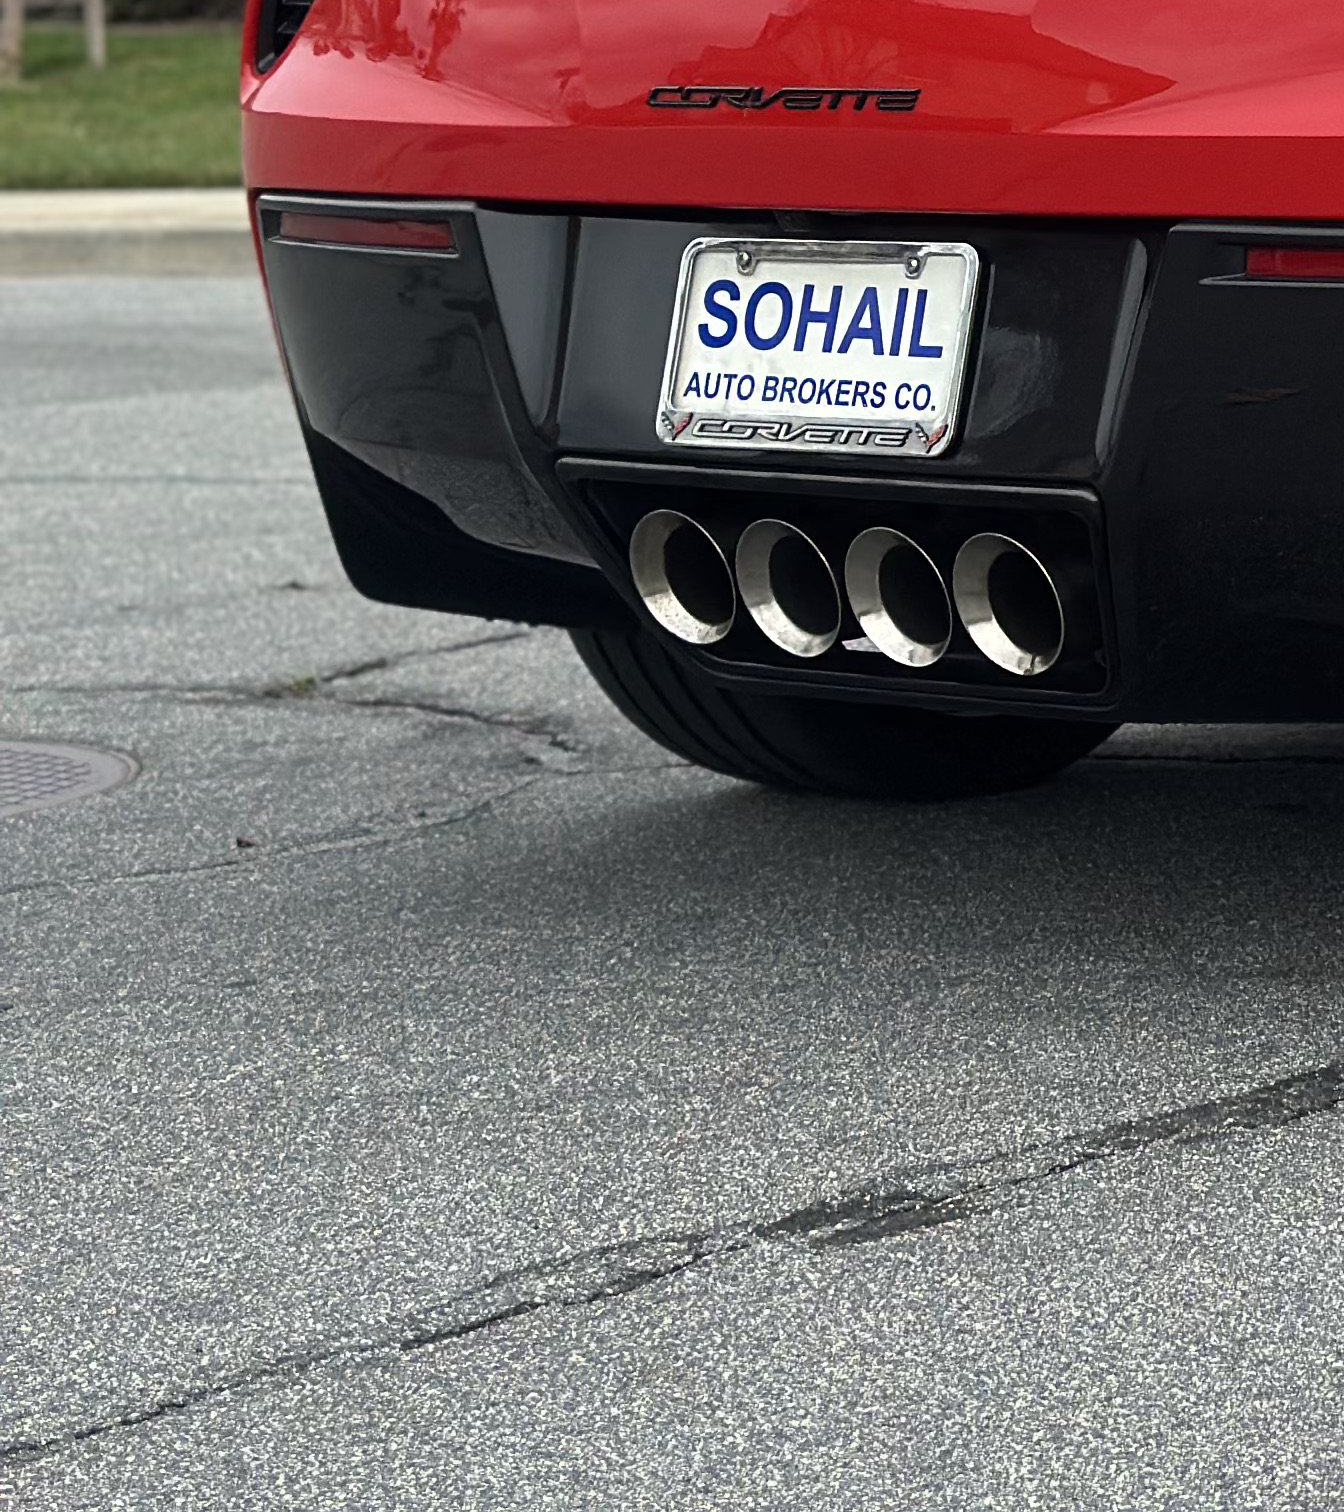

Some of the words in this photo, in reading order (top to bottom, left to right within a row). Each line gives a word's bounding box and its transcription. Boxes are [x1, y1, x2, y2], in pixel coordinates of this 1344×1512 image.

[648, 86, 921, 111] CORVETTE
[697, 279, 943, 359] SOHAIL
[683, 371, 755, 402] AUTO
[762, 376, 886, 409] BROKERS
[894, 382, 937, 412] CO.
[691, 417, 912, 448] CORVETTE
